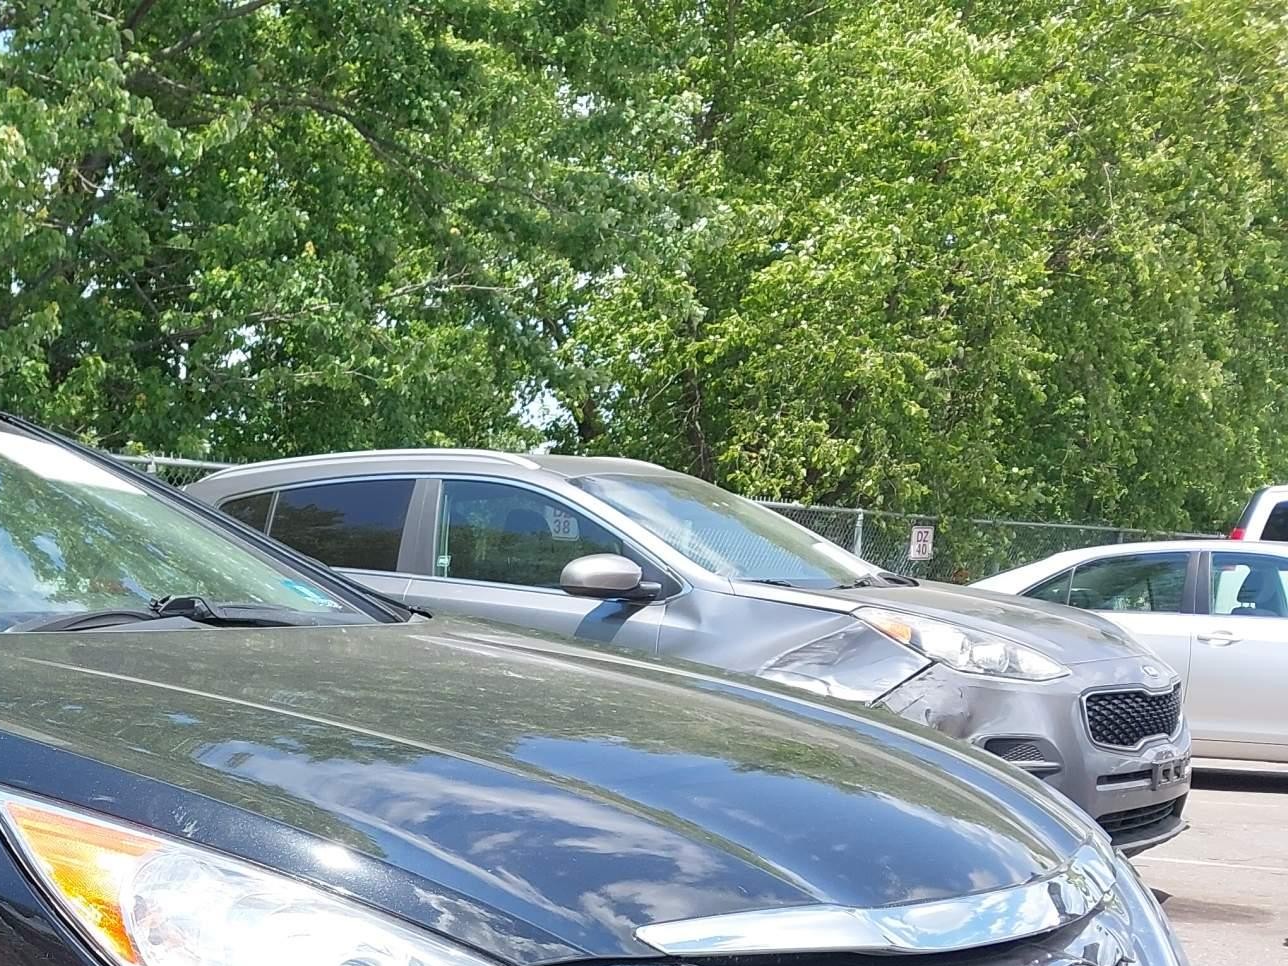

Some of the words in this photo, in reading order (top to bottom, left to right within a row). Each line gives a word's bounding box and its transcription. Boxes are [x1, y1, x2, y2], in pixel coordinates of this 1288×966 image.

[554, 519, 570, 534] 38
[916, 530, 929, 543] DZ
[916, 543, 928, 555] 40
